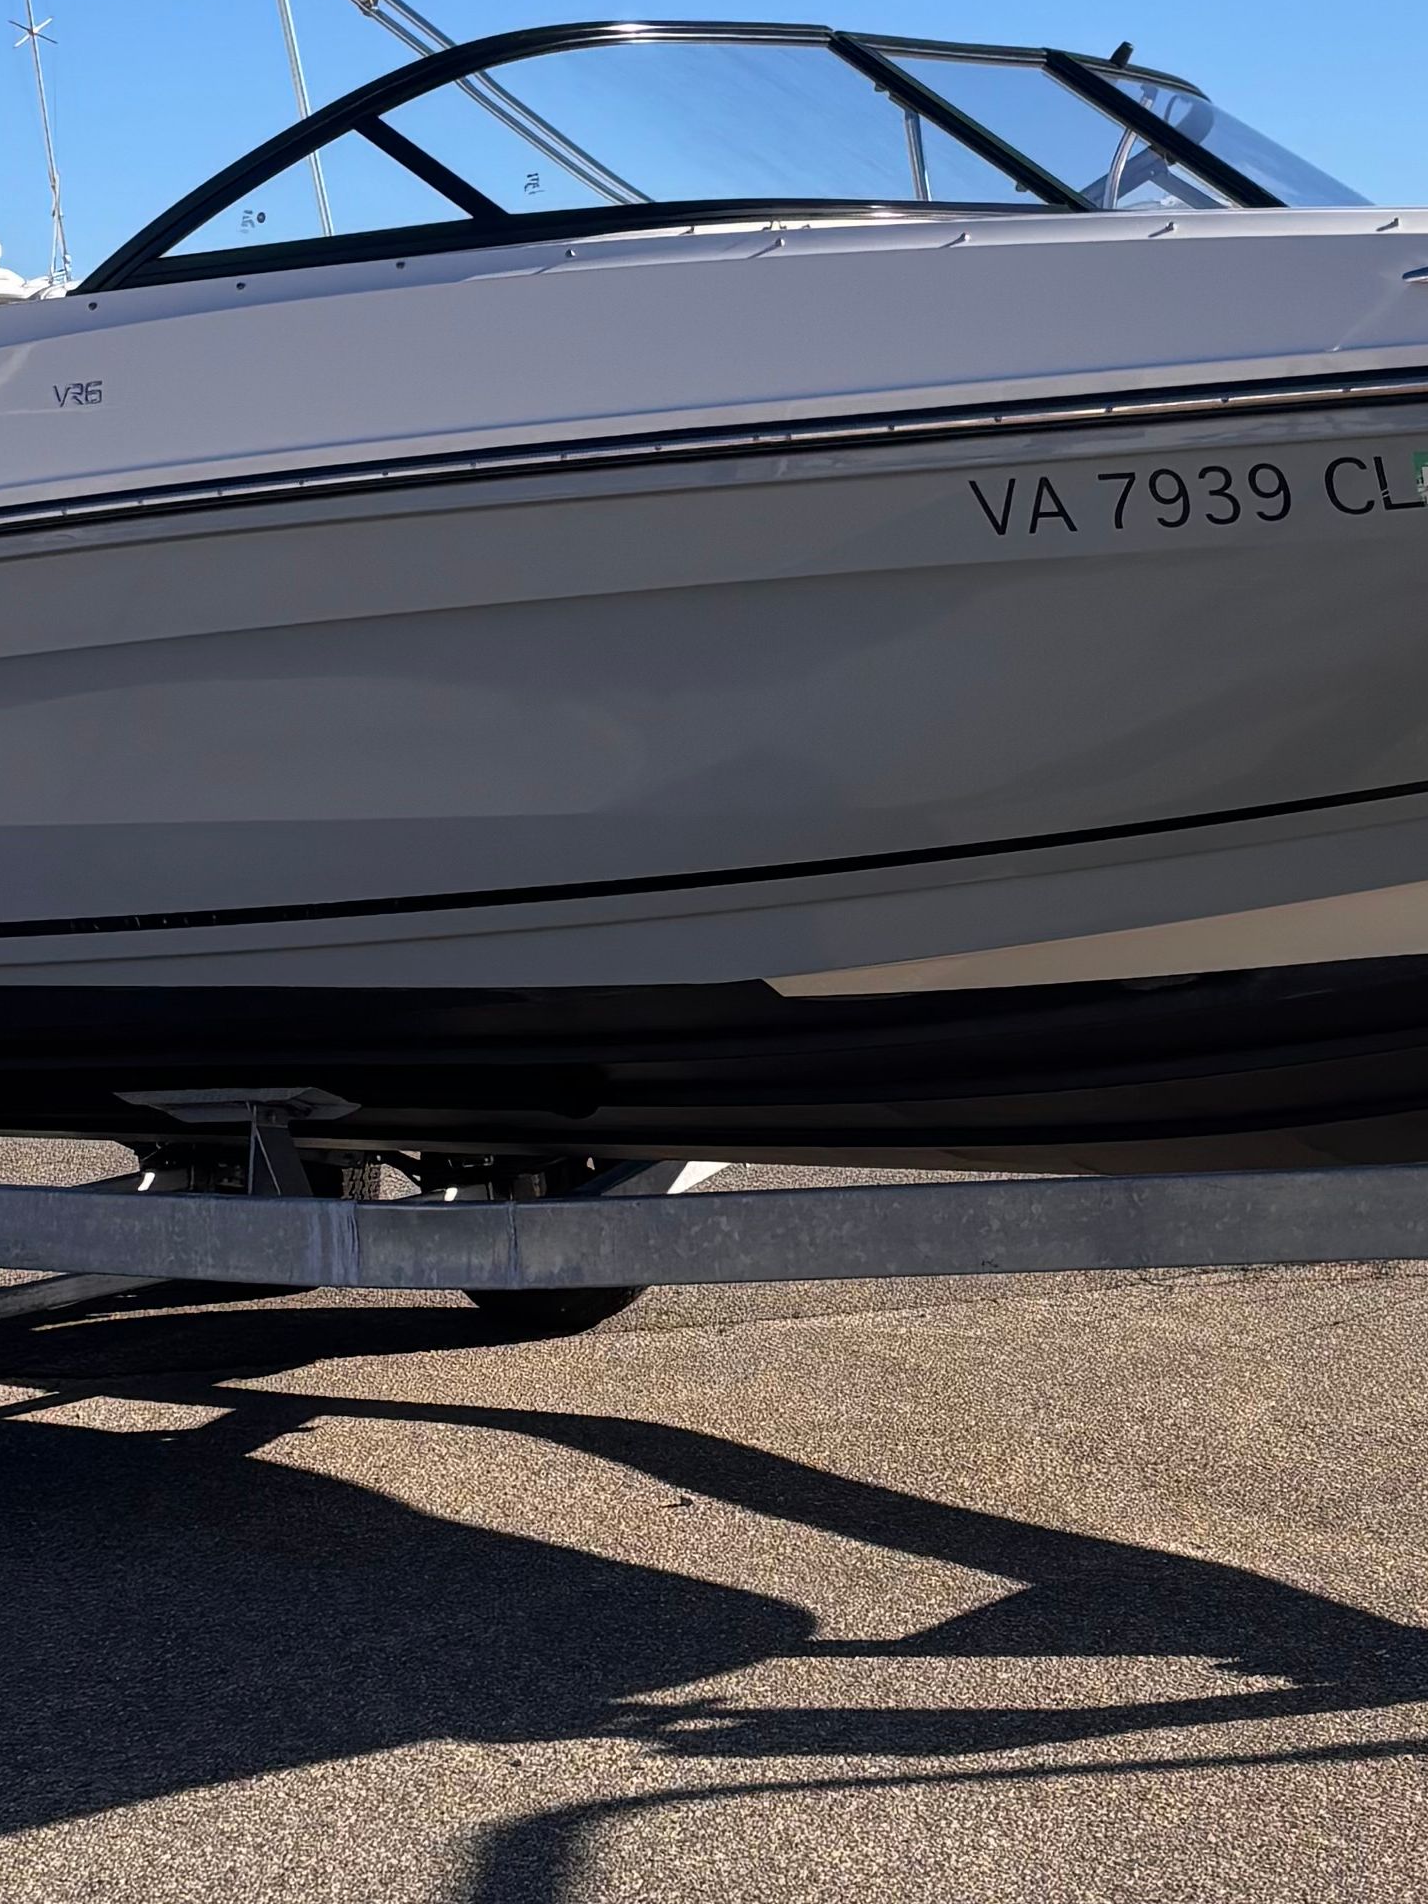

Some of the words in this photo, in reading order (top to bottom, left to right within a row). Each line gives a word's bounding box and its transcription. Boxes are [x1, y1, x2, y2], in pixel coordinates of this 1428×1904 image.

[53, 380, 103, 407] VR6
[968, 476, 1078, 535] VA
[1097, 462, 1292, 529] 7939
[1324, 456, 1426, 515] CL
